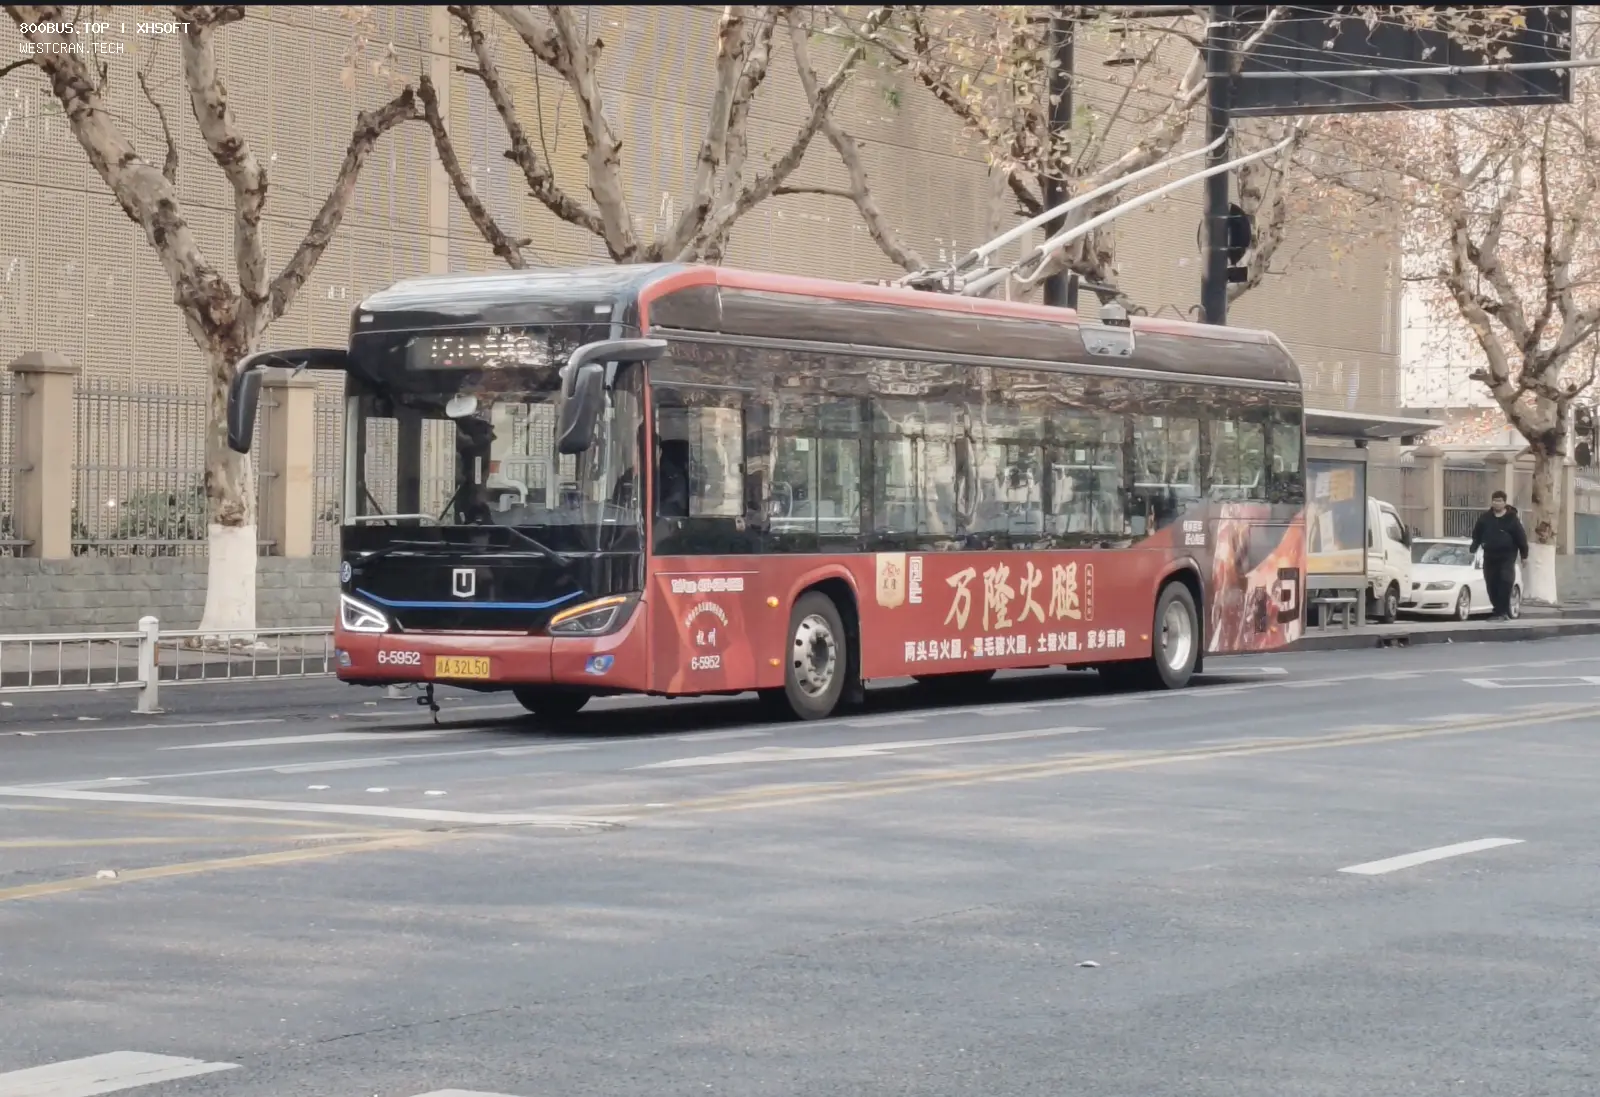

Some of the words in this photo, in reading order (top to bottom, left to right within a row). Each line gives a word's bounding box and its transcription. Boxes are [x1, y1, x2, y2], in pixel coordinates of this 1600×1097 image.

[943, 561, 1082, 632] 万隆火腿
[378, 651, 421, 665] 6-5952
[691, 655, 720, 670] 6-5952
